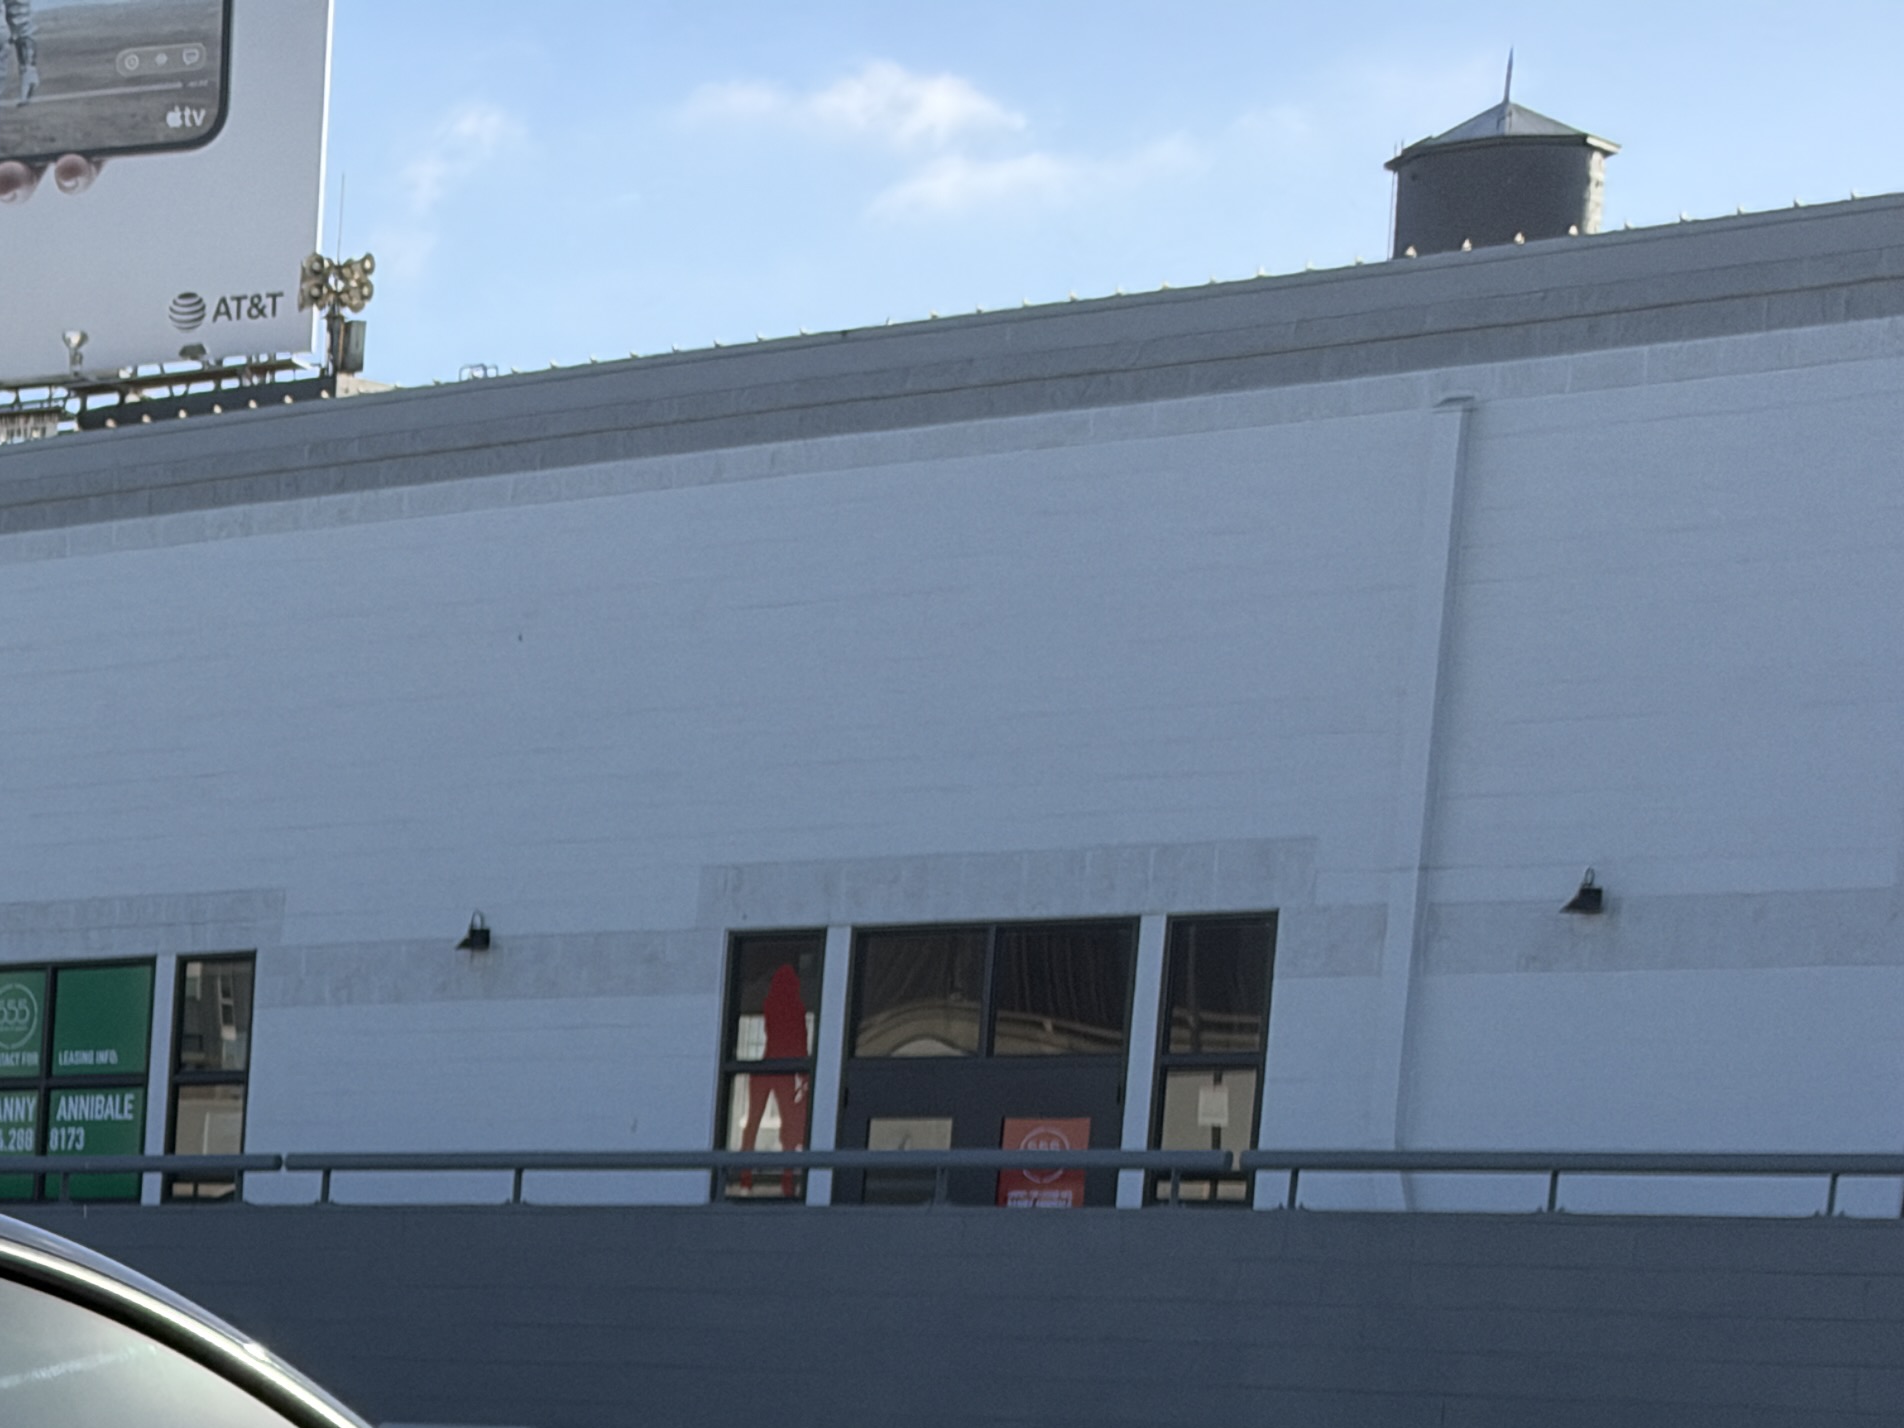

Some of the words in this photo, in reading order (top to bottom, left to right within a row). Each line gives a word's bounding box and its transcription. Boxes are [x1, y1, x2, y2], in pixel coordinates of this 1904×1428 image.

[183, 105, 206, 127] tv
[212, 291, 284, 323] AT&T
[56, 1093, 135, 1121] ANNIBALE
